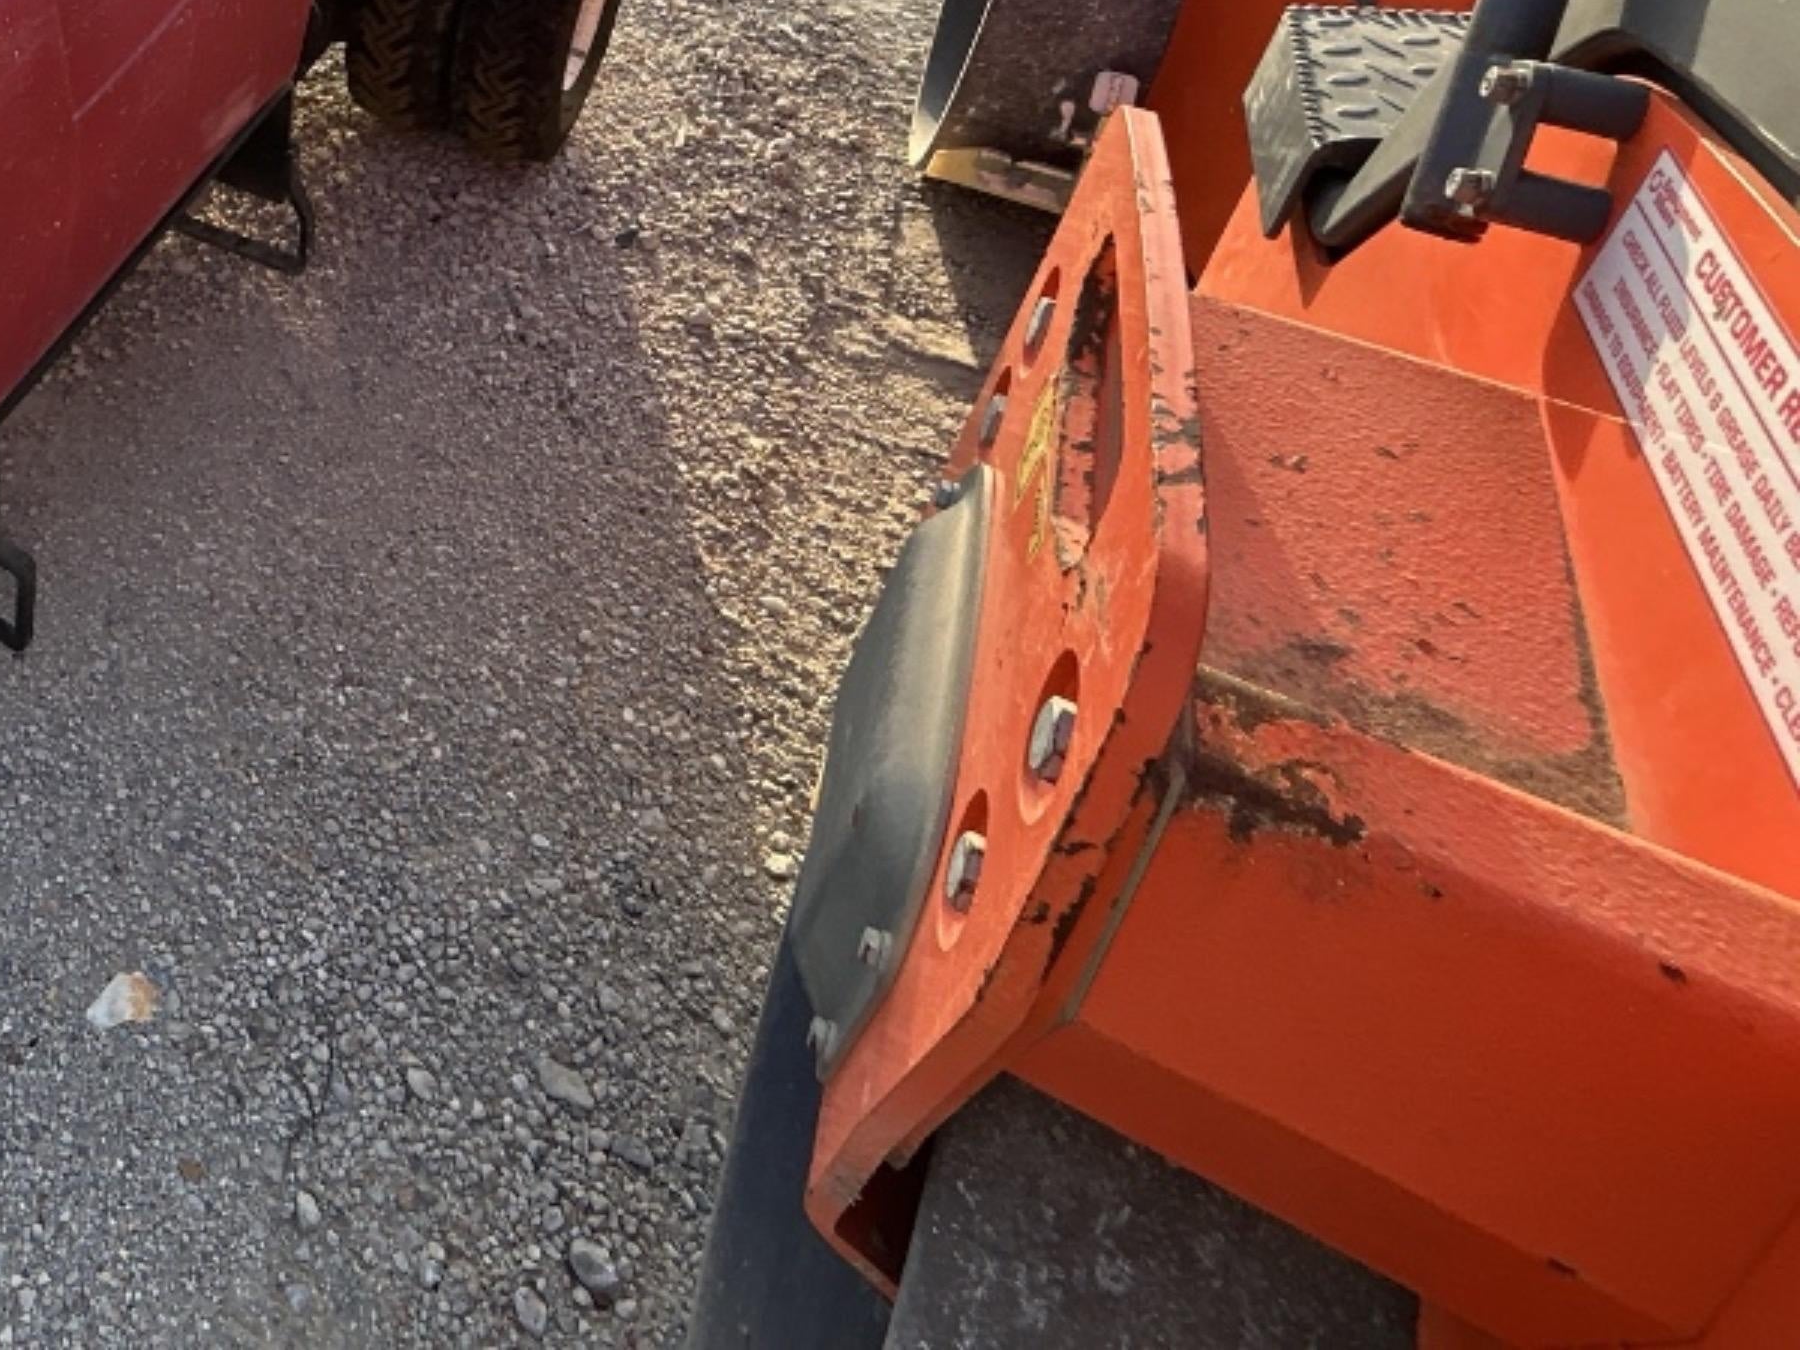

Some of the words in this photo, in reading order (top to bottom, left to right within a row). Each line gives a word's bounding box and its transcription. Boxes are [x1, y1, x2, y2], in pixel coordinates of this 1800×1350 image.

[1643, 269, 1663, 306] ALL
[1679, 337, 1716, 397] LEVELS
[1716, 407, 1760, 480] GREASE
[1752, 474, 1792, 534] DAILY
[1695, 249, 1788, 401] CUSTOMER
[1608, 332, 1623, 358] TO
[1617, 353, 1665, 444] EQUIPMENT
[1662, 450, 1706, 528] BATTERY
[1698, 525, 1777, 678] MAINTENANCE
[1656, 362, 1680, 402] FLAT
[1674, 395, 1705, 453] TIRES
[1703, 455, 1732, 507] TIRE
[1725, 500, 1777, 590] DAMAGE
